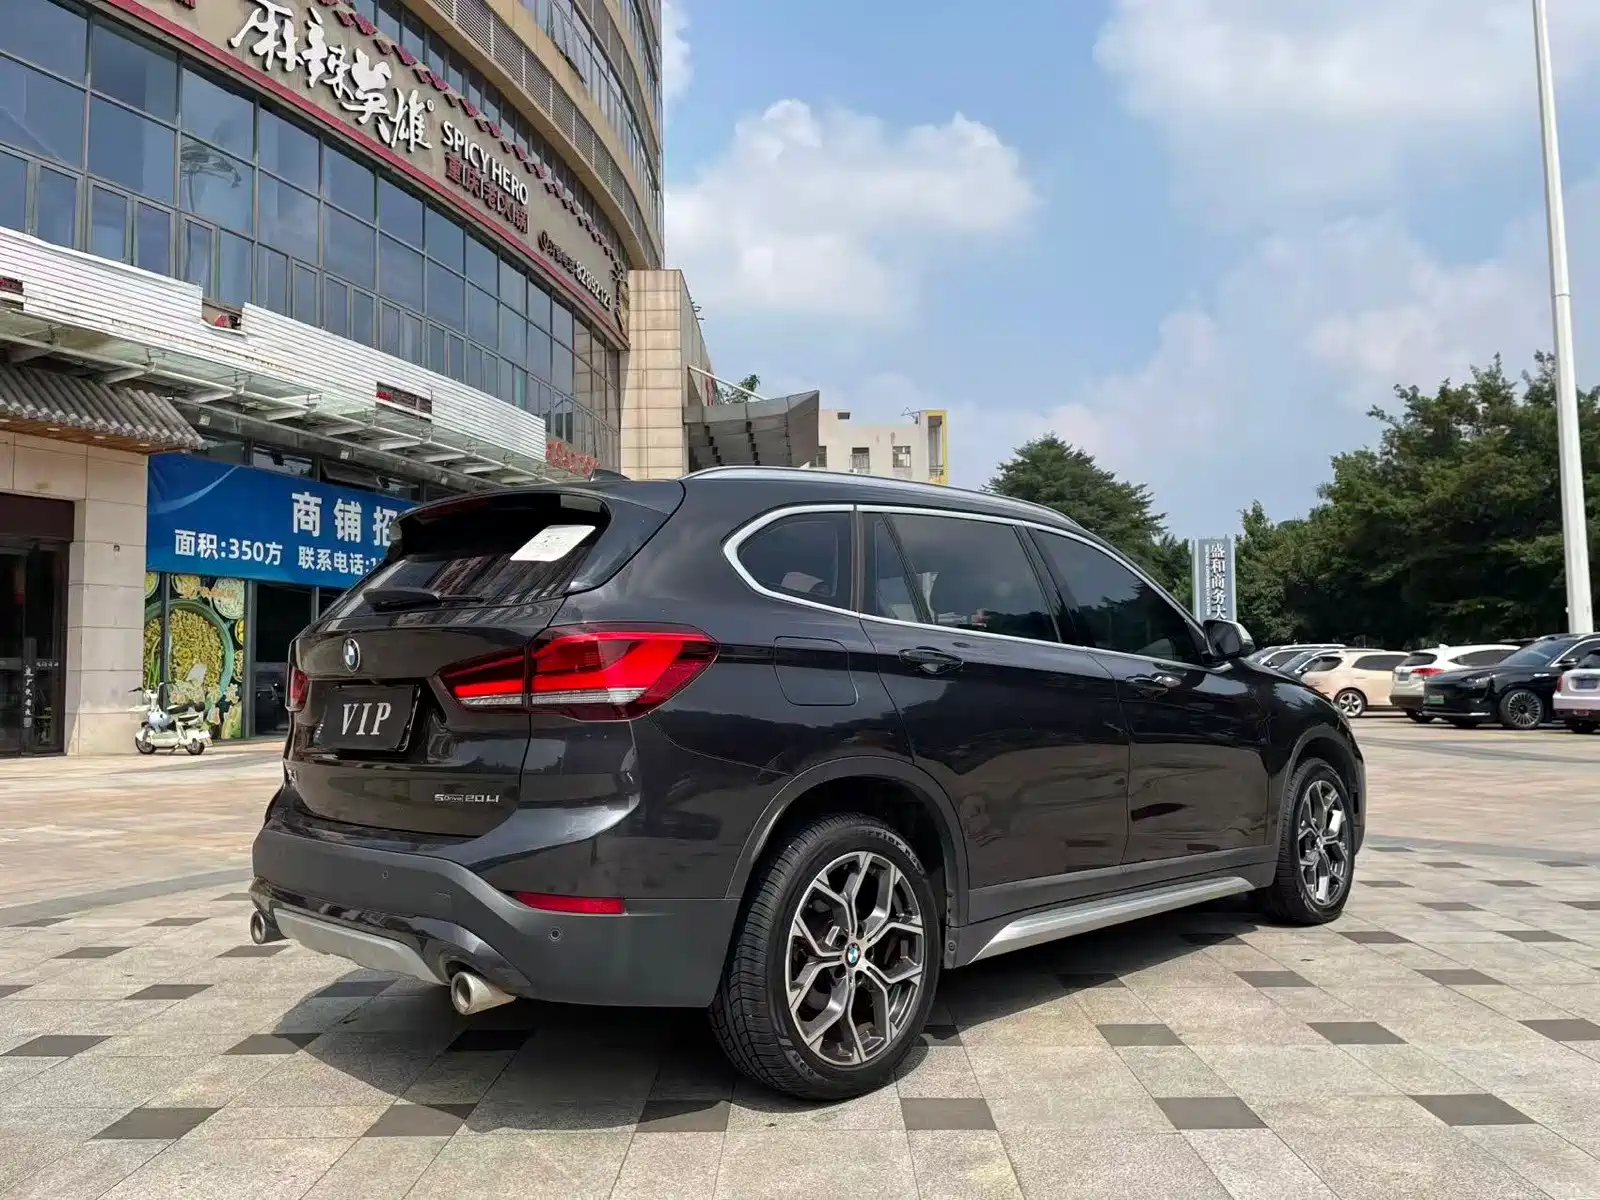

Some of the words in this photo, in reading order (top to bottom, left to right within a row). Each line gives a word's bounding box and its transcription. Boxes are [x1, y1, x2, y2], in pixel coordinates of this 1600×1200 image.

[228, 0, 434, 152] 麻辣英雄
[442, 120, 489, 174] SPICY
[489, 157, 529, 206] HERO
[174, 528, 283, 567] 面积:350方
[291, 491, 398, 548] 商铺招
[341, 702, 392, 736] VIP
